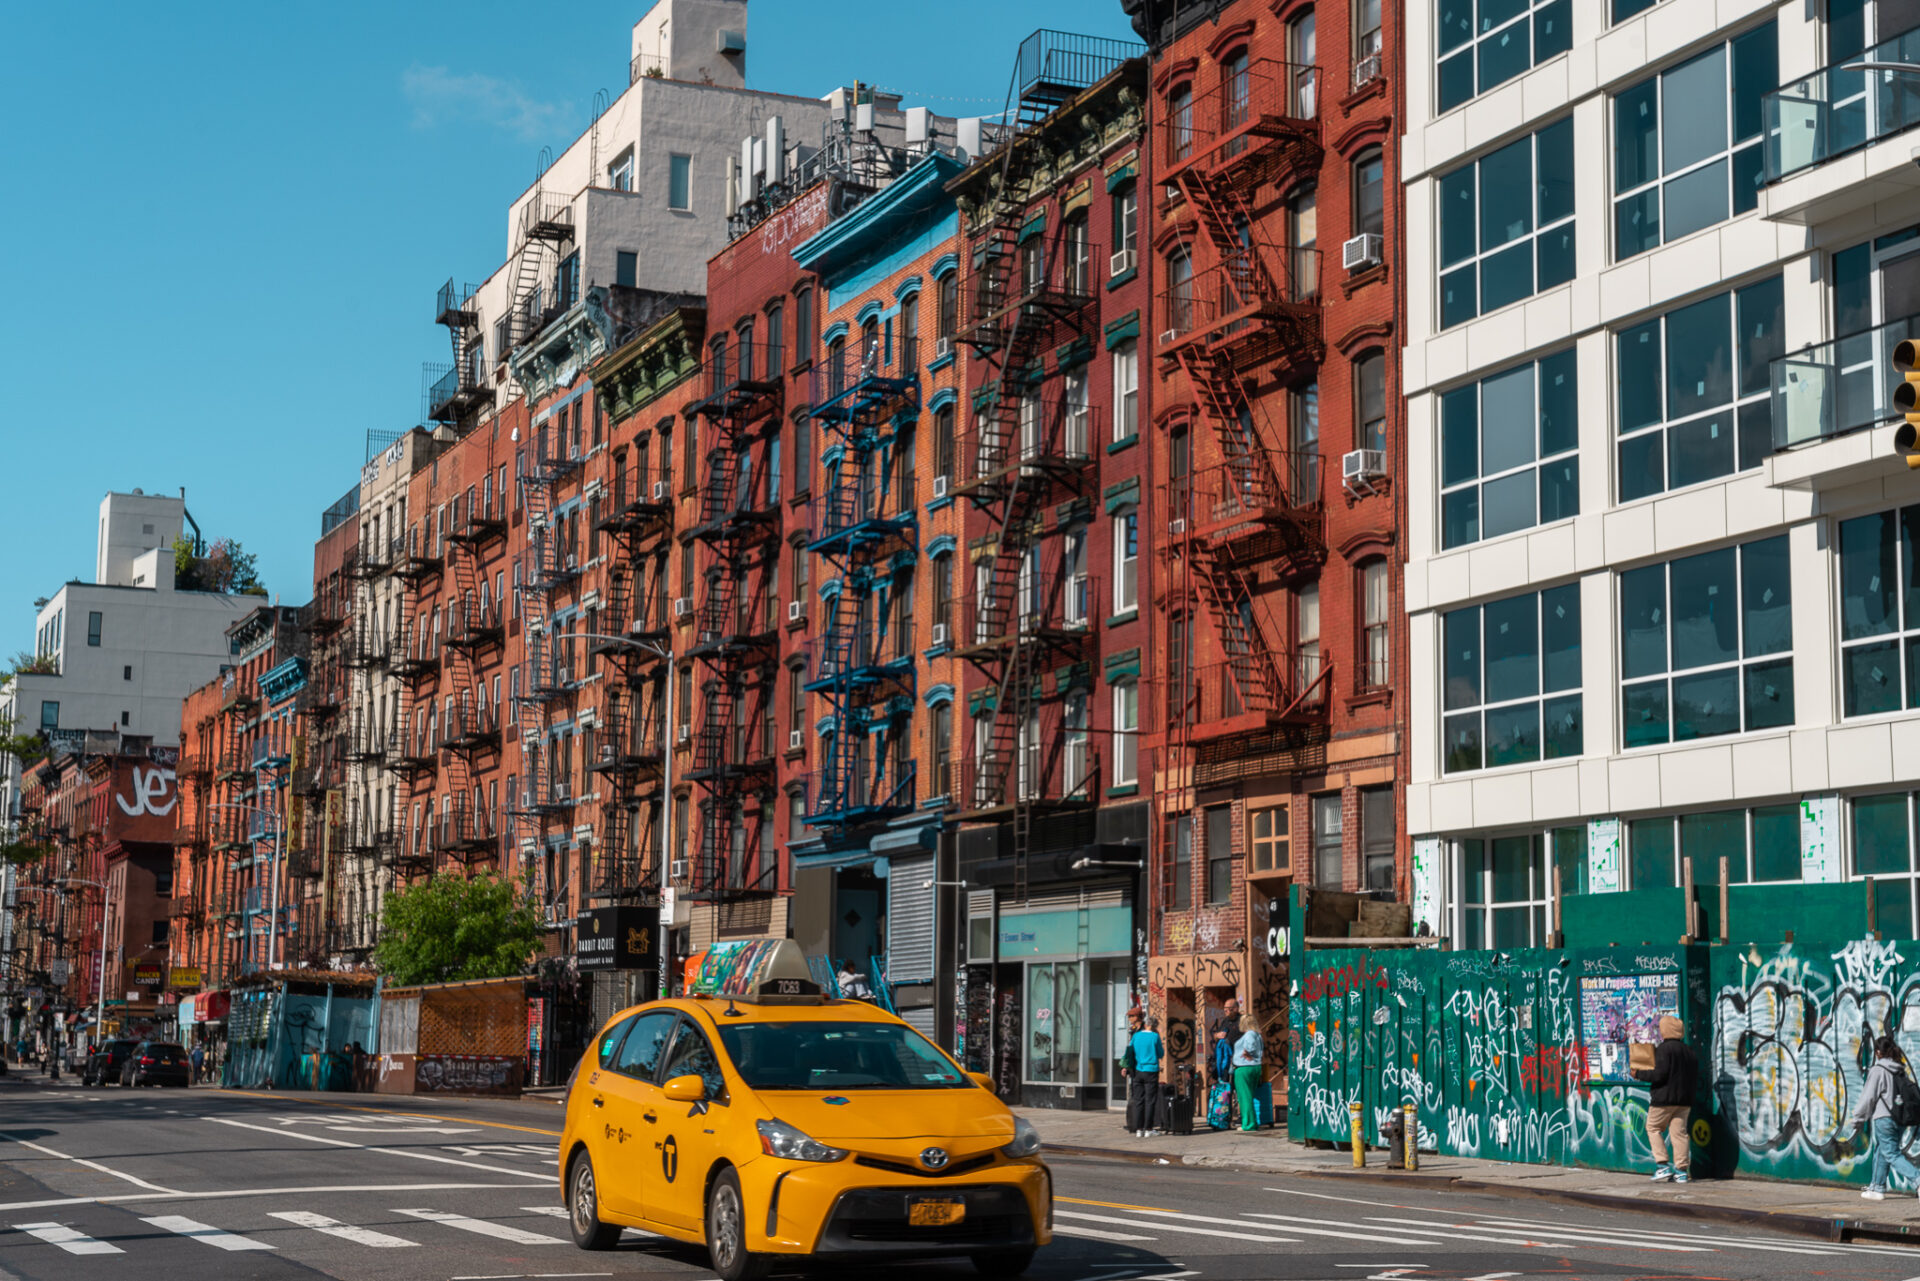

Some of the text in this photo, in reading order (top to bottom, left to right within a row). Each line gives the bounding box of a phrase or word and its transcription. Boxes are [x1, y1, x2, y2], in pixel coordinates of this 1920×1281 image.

[578, 937, 615, 952] RABBIT HOUSE
[135, 977, 160, 985] CANDY
[777, 980, 801, 994] 7C63
[1605, 976, 1636, 989] Progress:
[1639, 974, 1678, 988] MIXED-USE
